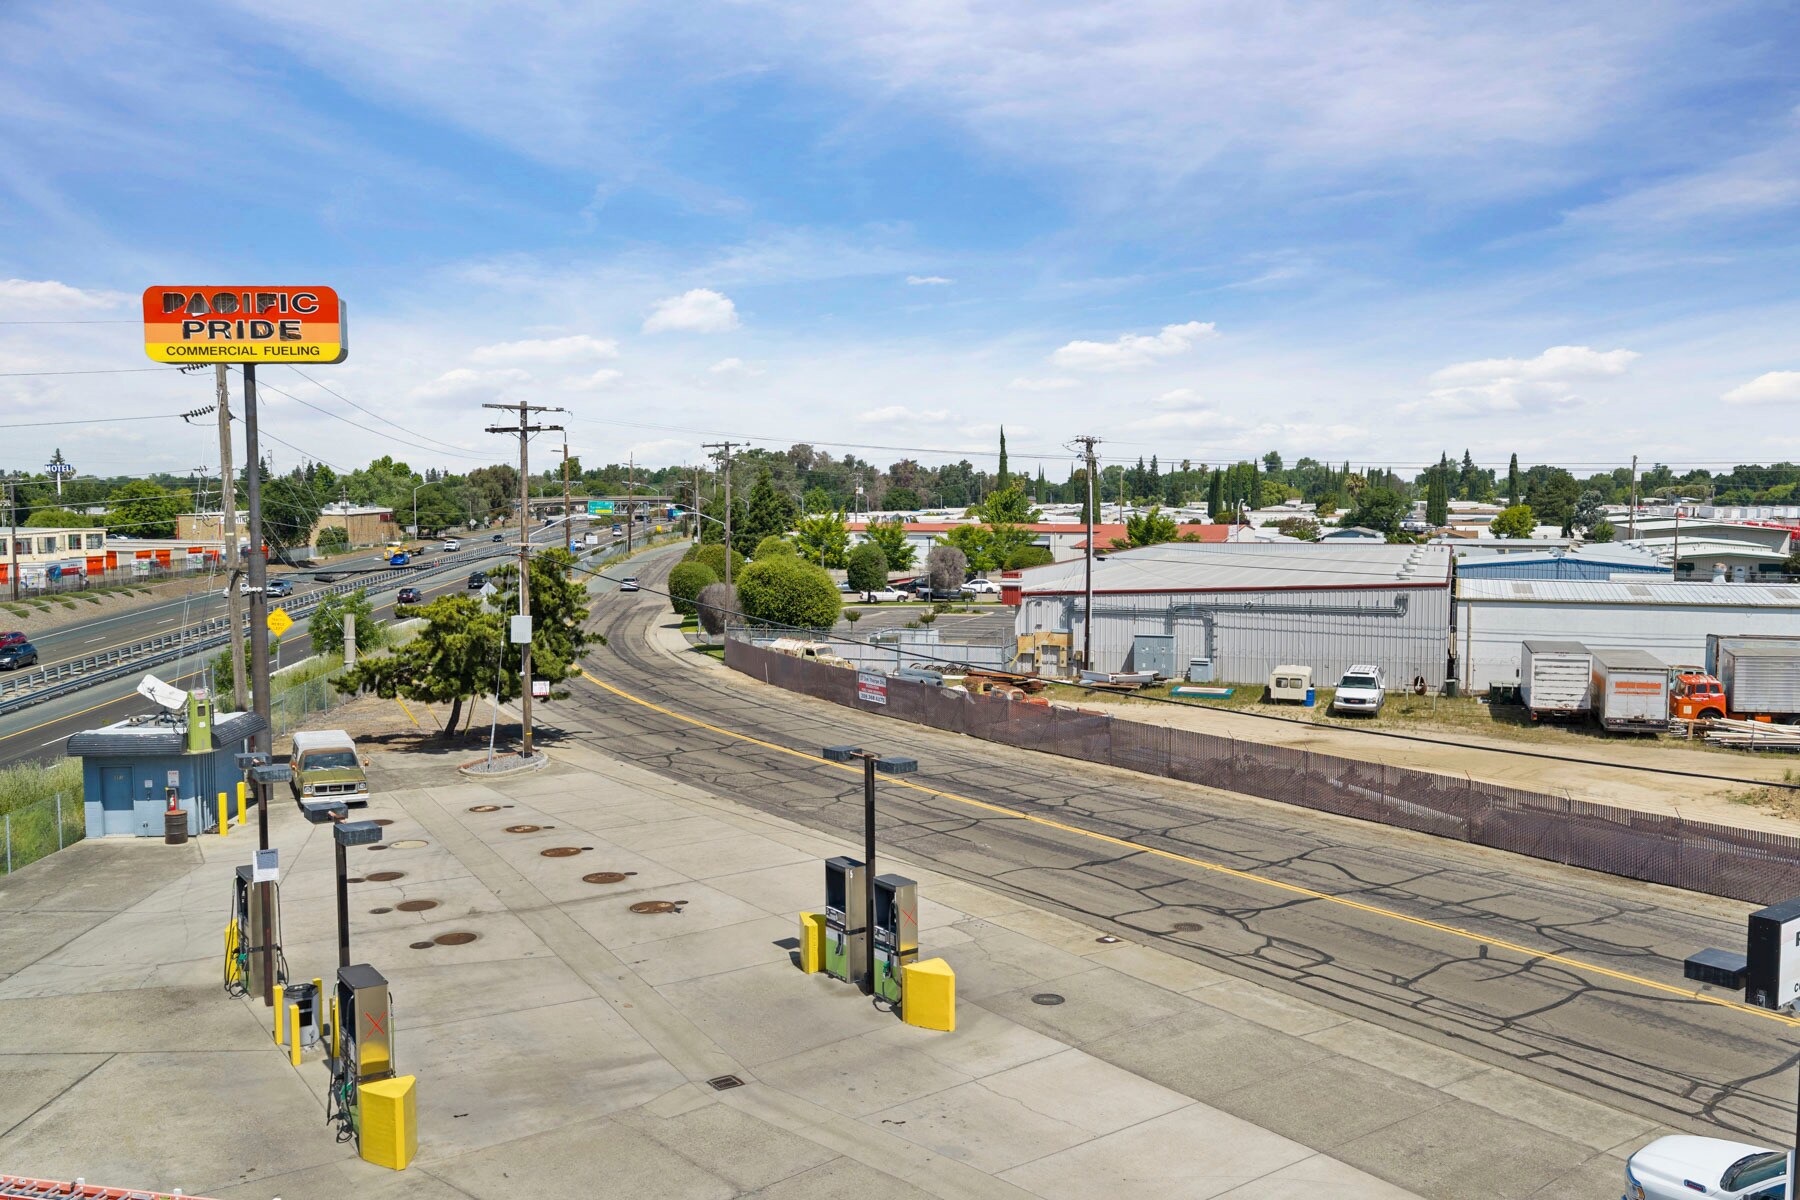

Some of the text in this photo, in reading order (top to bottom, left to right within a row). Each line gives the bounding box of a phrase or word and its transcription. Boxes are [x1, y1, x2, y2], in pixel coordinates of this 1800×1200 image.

[162, 292, 319, 314] PACIFIC
[182, 319, 302, 341] PRIDE
[166, 346, 320, 356] COMMERCIAL FUELING
[45, 464, 71, 473] MOTEL
